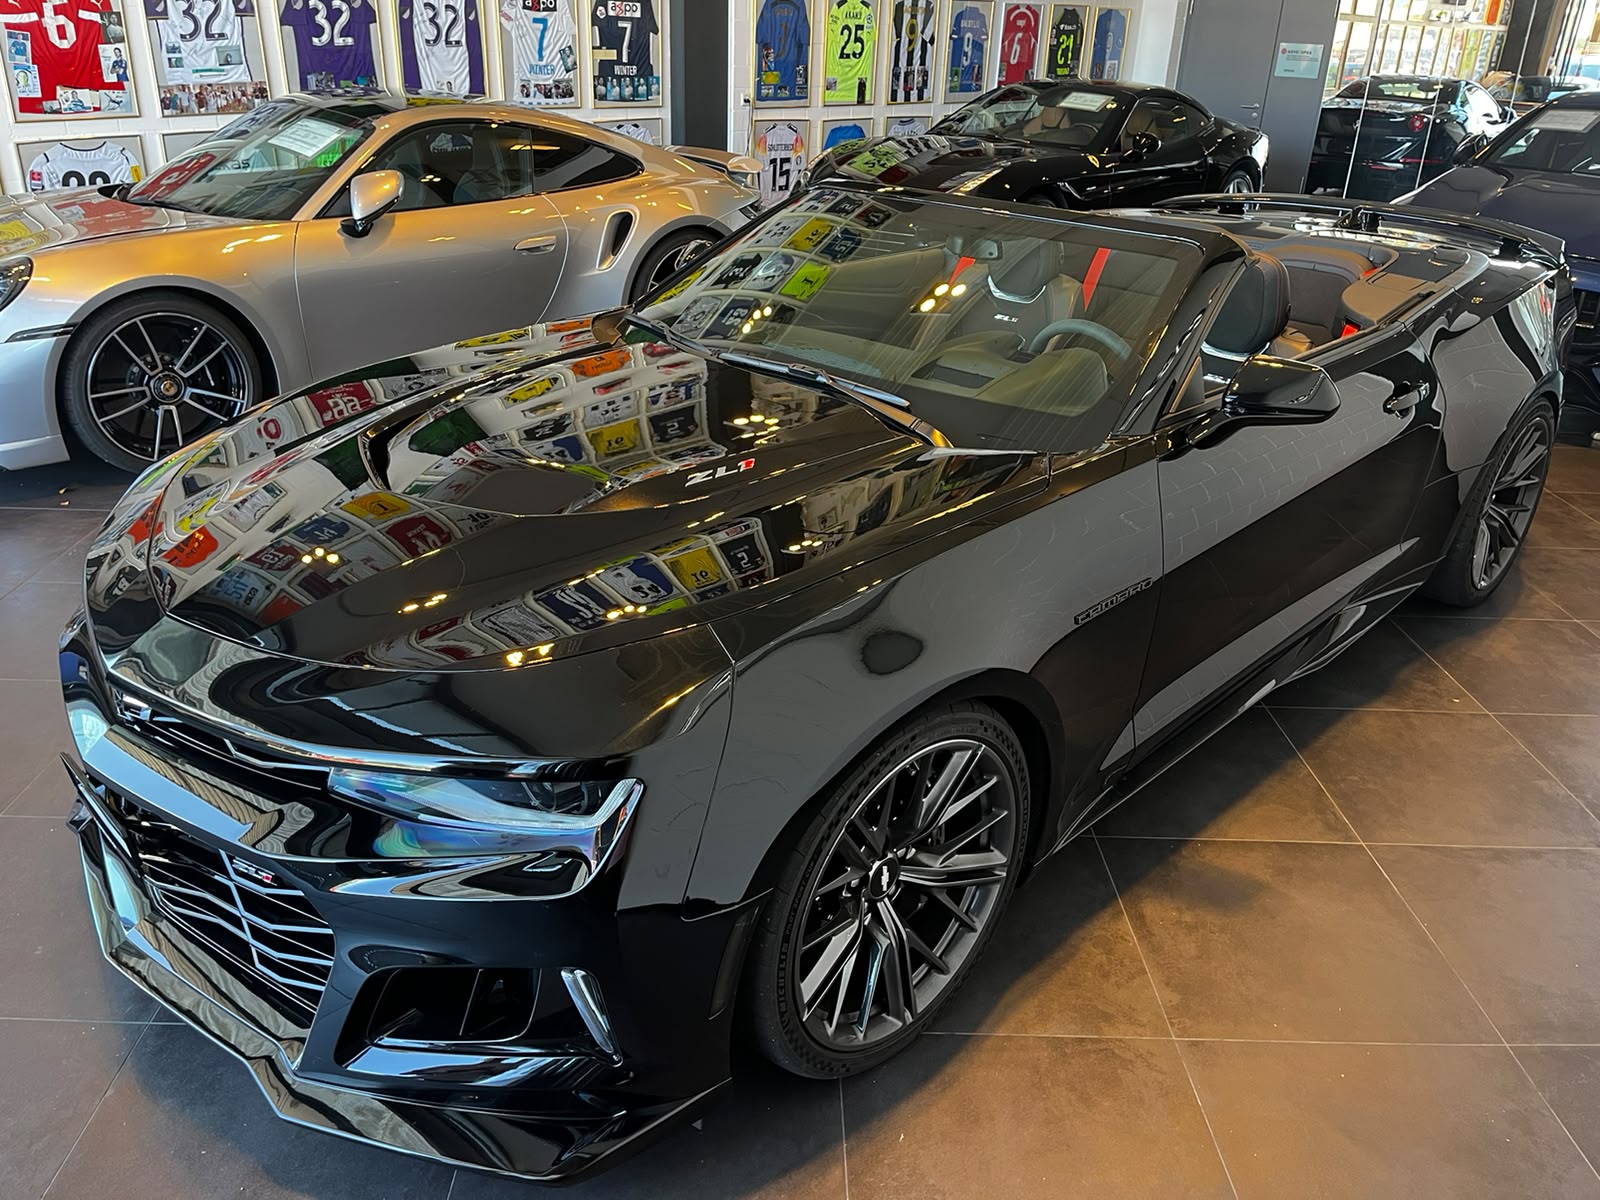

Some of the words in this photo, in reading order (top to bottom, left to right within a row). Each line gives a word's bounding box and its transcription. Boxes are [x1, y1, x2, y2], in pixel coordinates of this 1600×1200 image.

[41, 1, 77, 49] 6
[175, 0, 229, 42] 32
[309, 0, 355, 47] 32
[424, 2, 464, 48] 32
[905, 18, 918, 52] 9
[532, 17, 549, 62] 7
[618, 20, 633, 63] 7
[839, 24, 864, 60] 25
[962, 31, 974, 67] 9
[1009, 33, 1024, 65] 6
[1057, 34, 1074, 64] 21
[528, 64, 555, 75] WINTER
[613, 65, 638, 76] WINTER
[769, 157, 791, 192] 15
[685, 457, 756, 488] ZL1
[231, 859, 273, 884] ZL1
